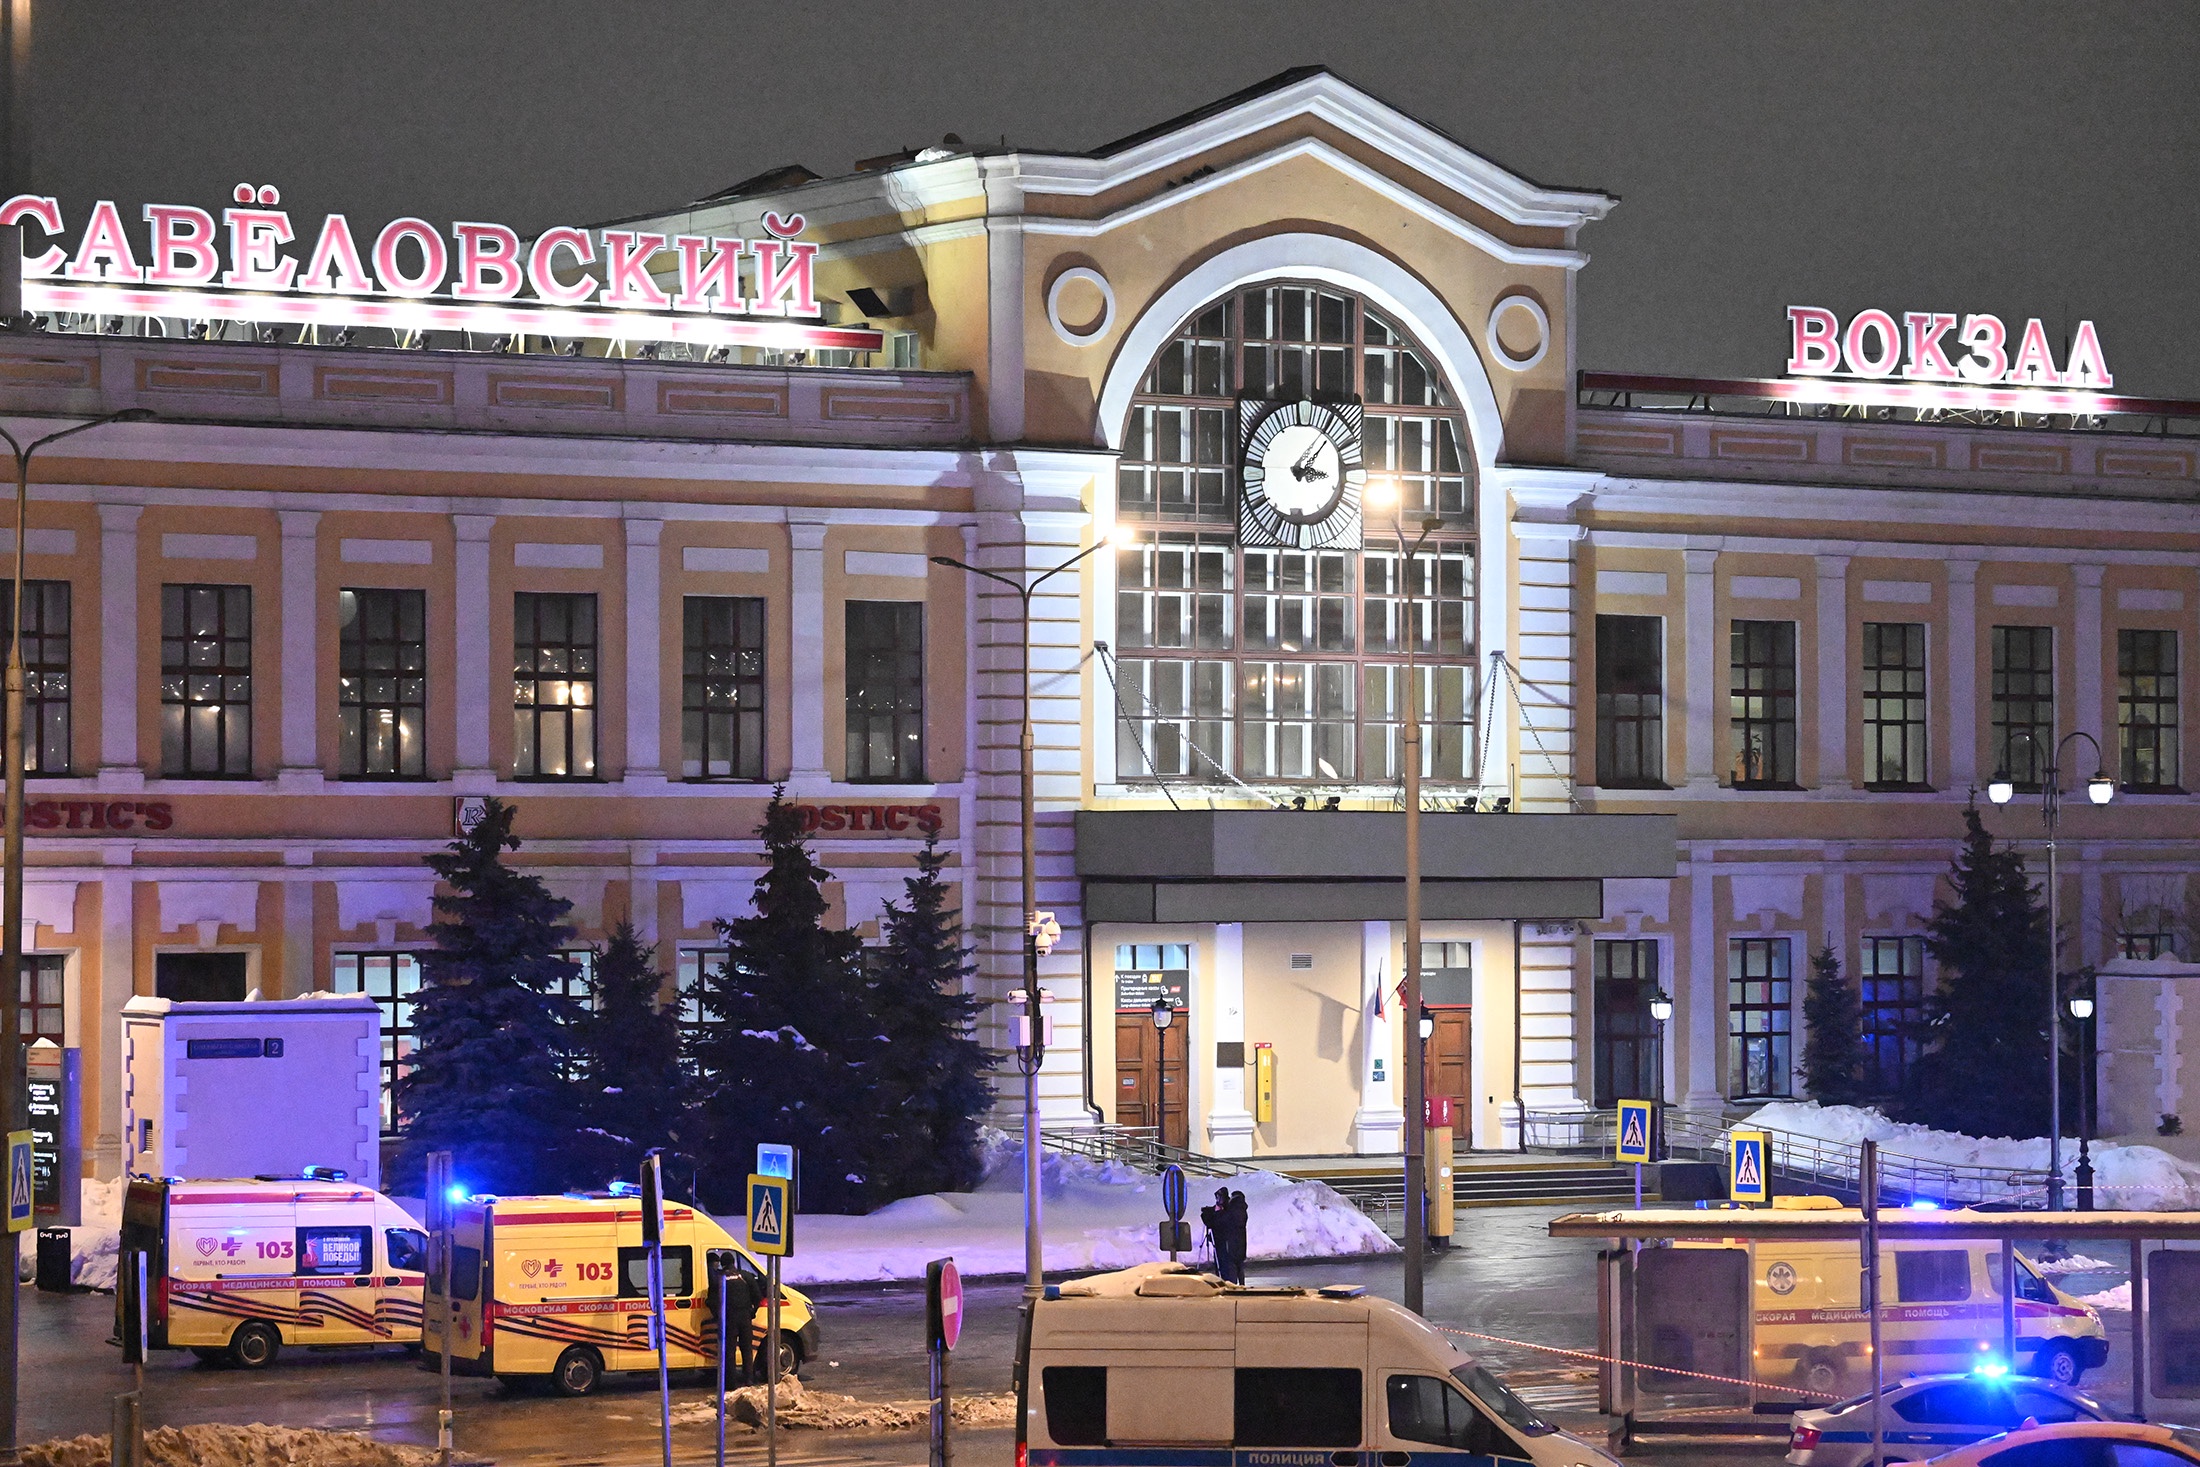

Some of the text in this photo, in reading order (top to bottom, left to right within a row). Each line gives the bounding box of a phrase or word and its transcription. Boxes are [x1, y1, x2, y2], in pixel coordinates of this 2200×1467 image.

[0, 182, 821, 317] САВЁЛОВСКИЙ
[1787, 304, 2114, 389] ВОКЗАЛ
[783, 804, 942, 832] OSTIC'S
[271, 1042, 279, 1054] 2
[256, 1241, 294, 1259] 103
[323, 1242, 360, 1252] ВЕЛИКОЙ
[323, 1252, 360, 1263] ПОБЕДЫ!
[576, 1262, 613, 1281] 103
[173, 1279, 346, 1291] СКОРАЯ МЕДИЦИНСКАЯ ПОМОЩЬ
[503, 1304, 568, 1315] МОСКОВСКАЯ
[578, 1301, 615, 1312] СКОРАЯ
[1905, 1308, 1950, 1318] ПОМОЩЬ
[1248, 1452, 1325, 1466] ПОЛИЦИЯ
